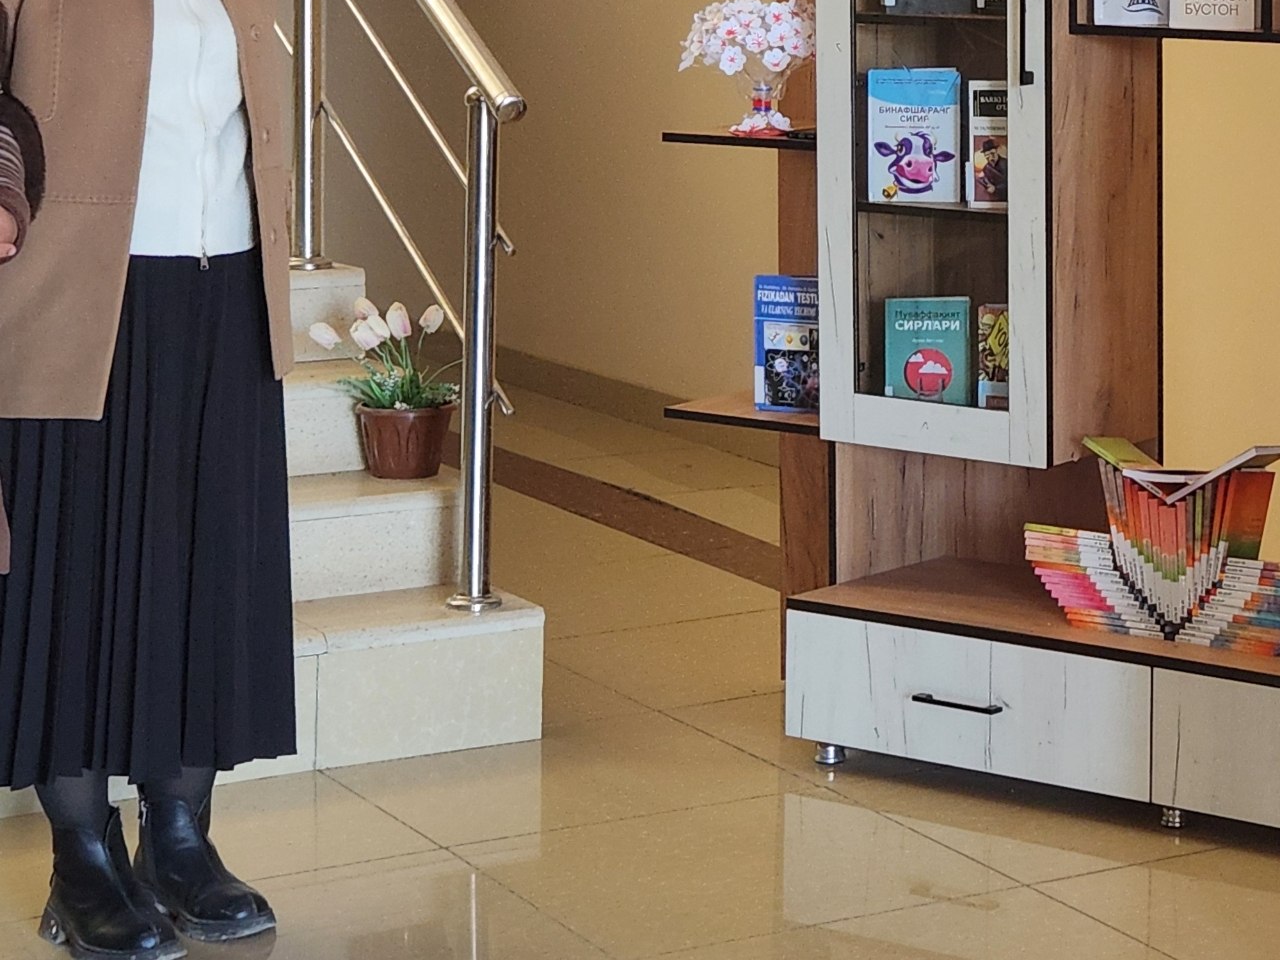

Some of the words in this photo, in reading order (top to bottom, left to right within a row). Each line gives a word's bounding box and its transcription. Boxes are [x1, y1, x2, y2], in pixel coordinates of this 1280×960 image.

[900, 115, 929, 123] СИГИР
[796, 292, 819, 305] TESTL
[894, 320, 960, 331] СИРЛАРИ
